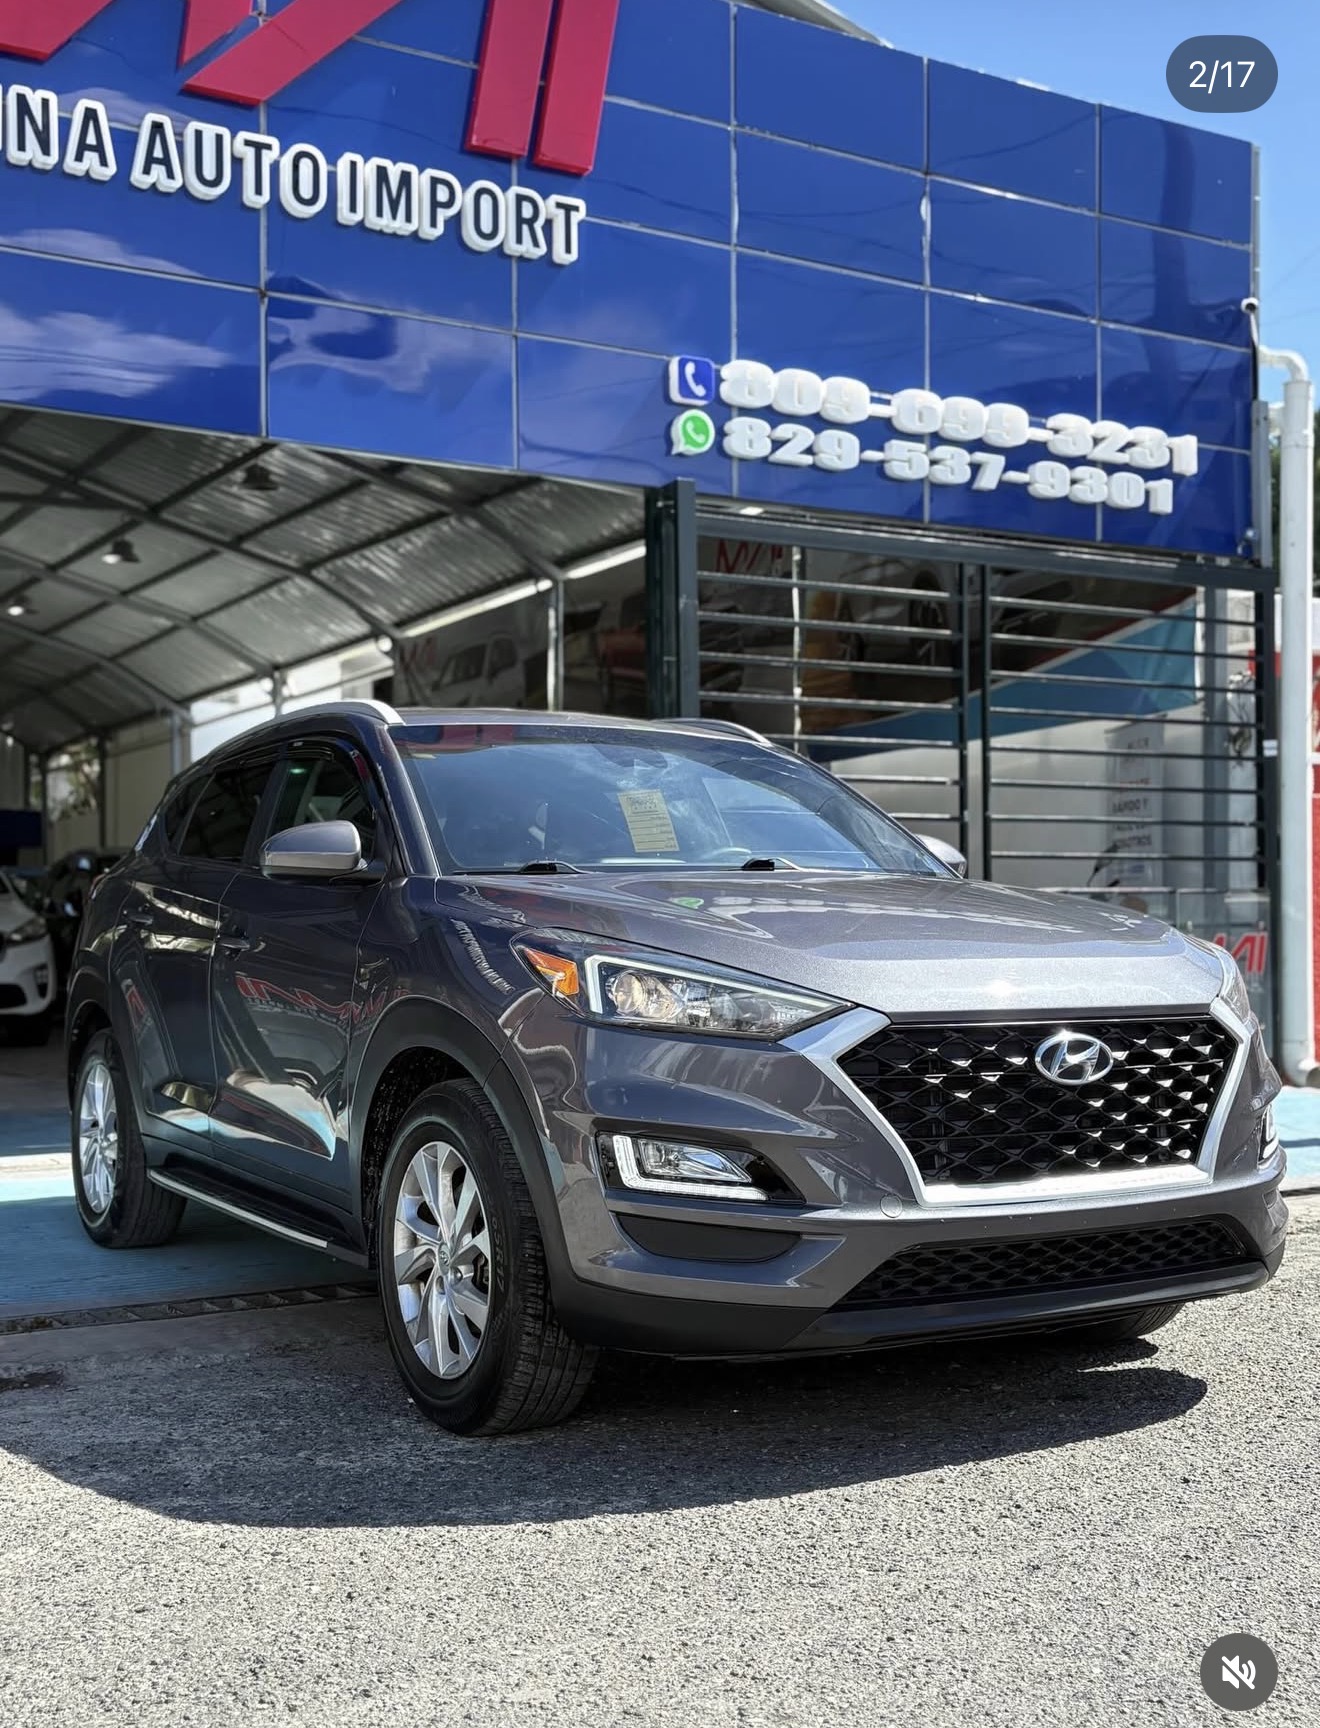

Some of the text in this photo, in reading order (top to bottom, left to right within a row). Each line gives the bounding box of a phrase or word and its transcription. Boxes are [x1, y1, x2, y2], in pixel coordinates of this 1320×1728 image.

[0, 84, 586, 265] NA AUTO IMPORT
[720, 359, 1198, 475] 809-699-3231
[722, 416, 1174, 514] 829-537-9301
